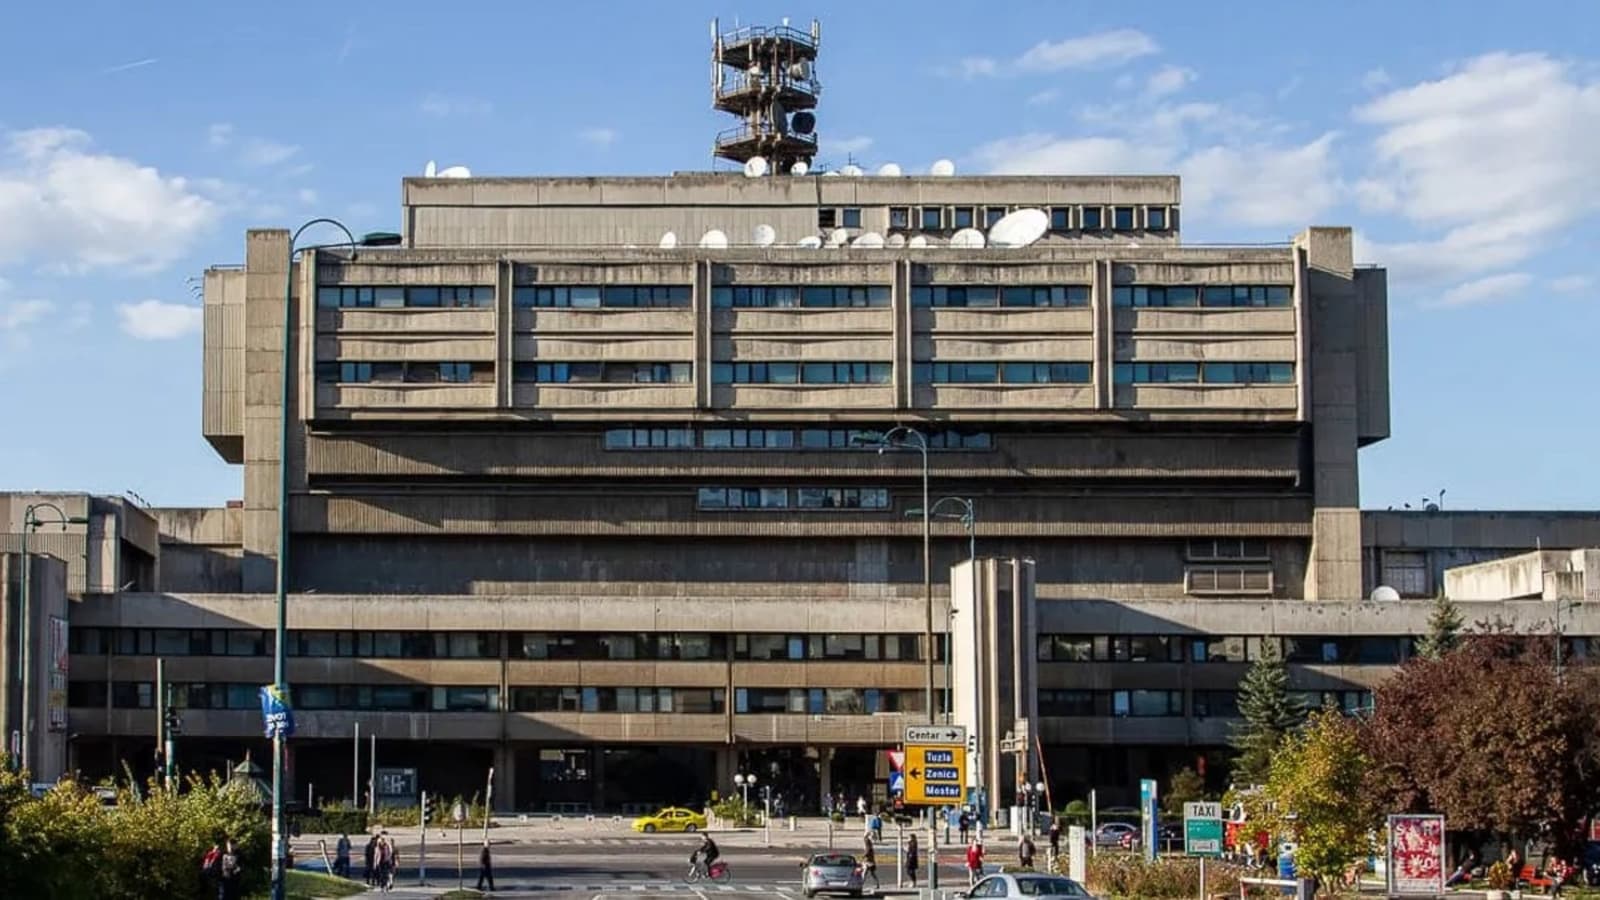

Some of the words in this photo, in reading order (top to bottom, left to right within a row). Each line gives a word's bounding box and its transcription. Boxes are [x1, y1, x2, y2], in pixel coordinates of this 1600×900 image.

[908, 731, 940, 740] Centar
[926, 752, 951, 762] Tuzla
[926, 769, 957, 779] Zenica
[926, 786, 960, 796] Mostar
[1192, 804, 1215, 816] TAXI
